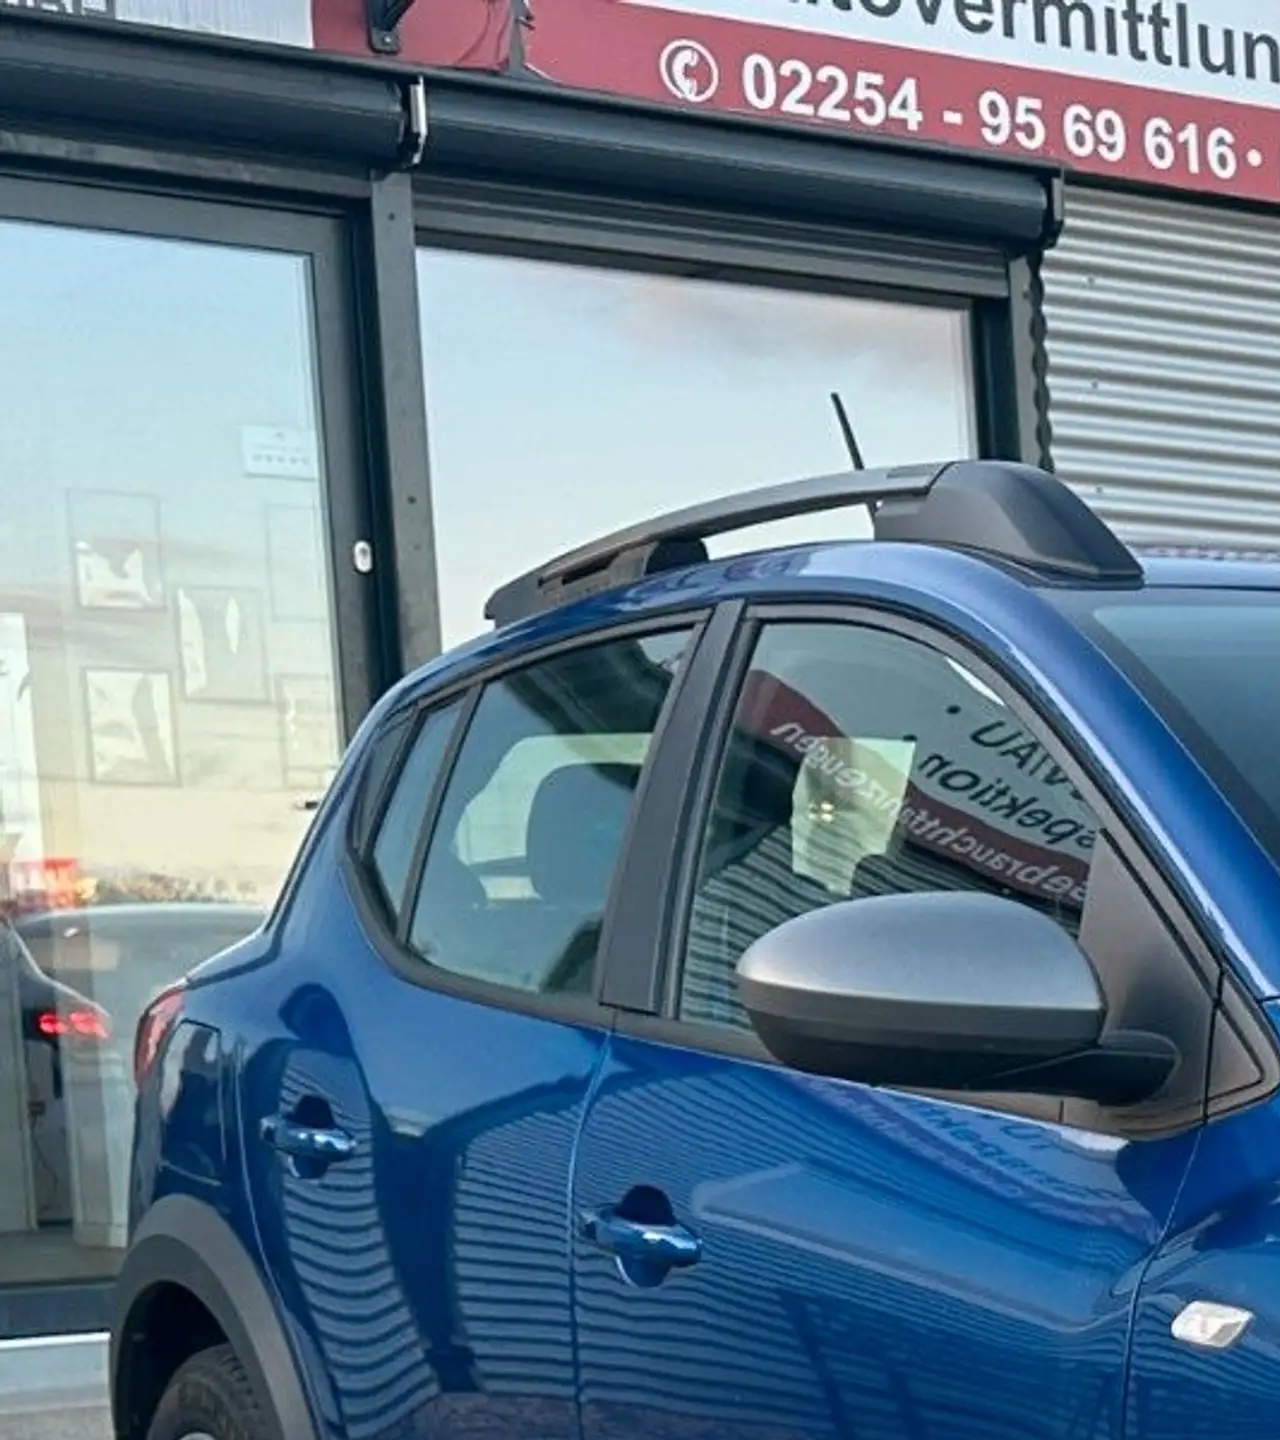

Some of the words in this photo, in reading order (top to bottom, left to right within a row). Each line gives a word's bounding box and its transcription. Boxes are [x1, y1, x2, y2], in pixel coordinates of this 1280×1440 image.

[741, 52, 924, 133] 02254
[978, 89, 1046, 150] 95
[1062, 103, 1127, 163] 69
[1143, 116, 1238, 180] 616
